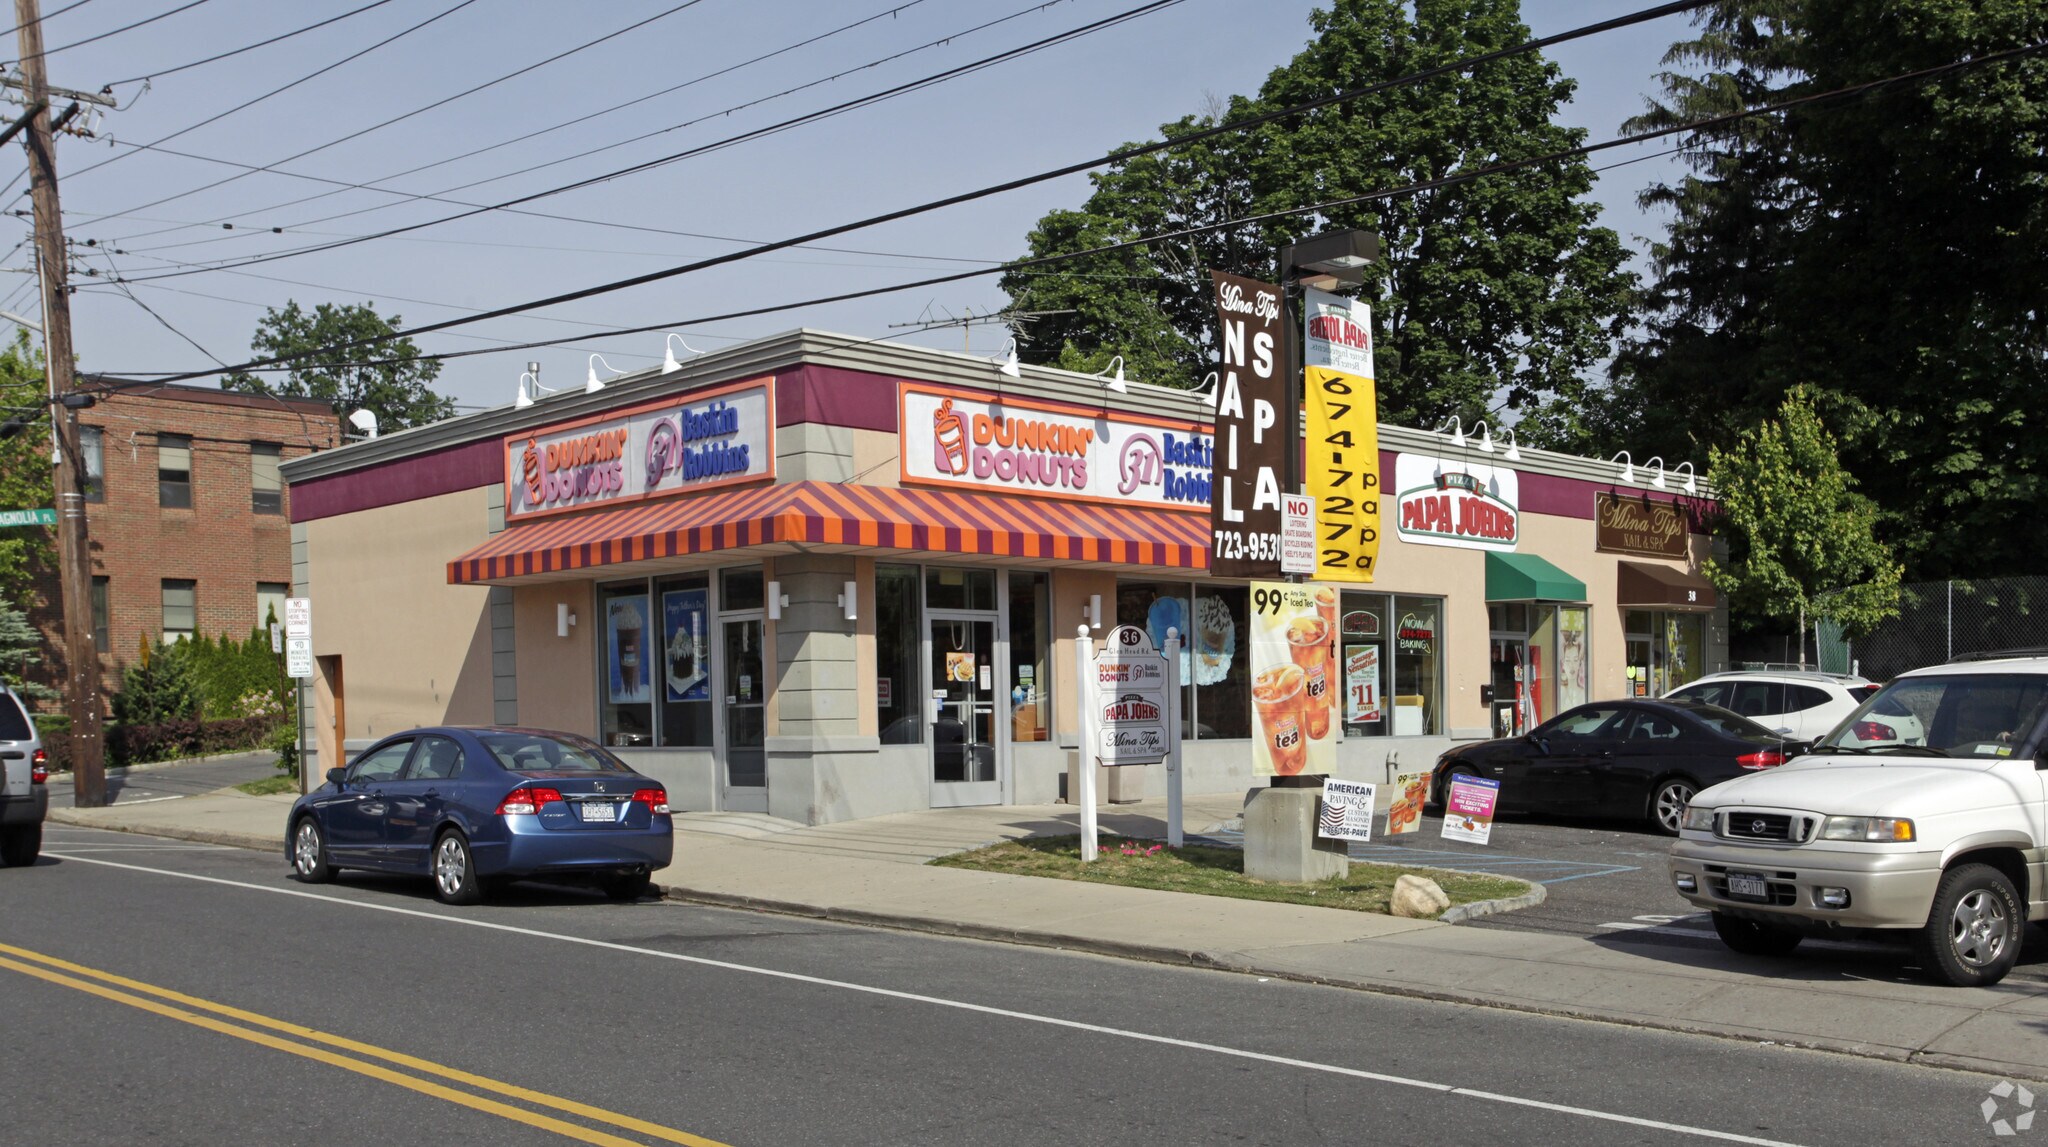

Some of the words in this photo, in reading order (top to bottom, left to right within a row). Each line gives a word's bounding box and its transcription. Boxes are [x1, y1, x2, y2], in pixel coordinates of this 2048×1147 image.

[1255, 290, 1280, 328] Tips
[681, 401, 739, 442] Baskin
[973, 413, 1094, 457] DUNKIN'
[546, 428, 627, 472] DUNKIN'
[1163, 433, 1213, 469] Baski
[682, 440, 750, 481] Robbins
[973, 447, 1088, 488] DONUTS
[545, 462, 624, 502] DONUTS
[1163, 468, 1213, 504] Robbi
[1446, 475, 1476, 489] PIZZA
[1287, 500, 1309, 516] NO
[1402, 495, 1453, 533] PAPA
[1601, 500, 1650, 532] Mina
[0, 510, 39, 525] AGNOLIA
[1652, 508, 1682, 544] Tips
[1623, 533, 1642, 548] NAIL
[1643, 536, 1649, 549] &
[1650, 537, 1664, 550] SPA
[1290, 599, 1304, 607] Iced
[1304, 599, 1314, 608] Tea
[1122, 630, 1138, 644] 36
[1400, 638, 1427, 649] BAKING
[1099, 663, 1131, 673] DUNKIN'
[1099, 673, 1129, 682] DONUTS
[1306, 679, 1325, 697] tea
[1105, 703, 1129, 720] PAPA
[1105, 731, 1137, 747] Mina
[1139, 730, 1160, 750] Tips
[1275, 731, 1298, 748] tea
[1327, 782, 1373, 797] AMERICAN
[1329, 794, 1358, 806] PAVING
[1465, 800, 1489, 809] EXCITING
[1347, 809, 1370, 817] CUSTOM
